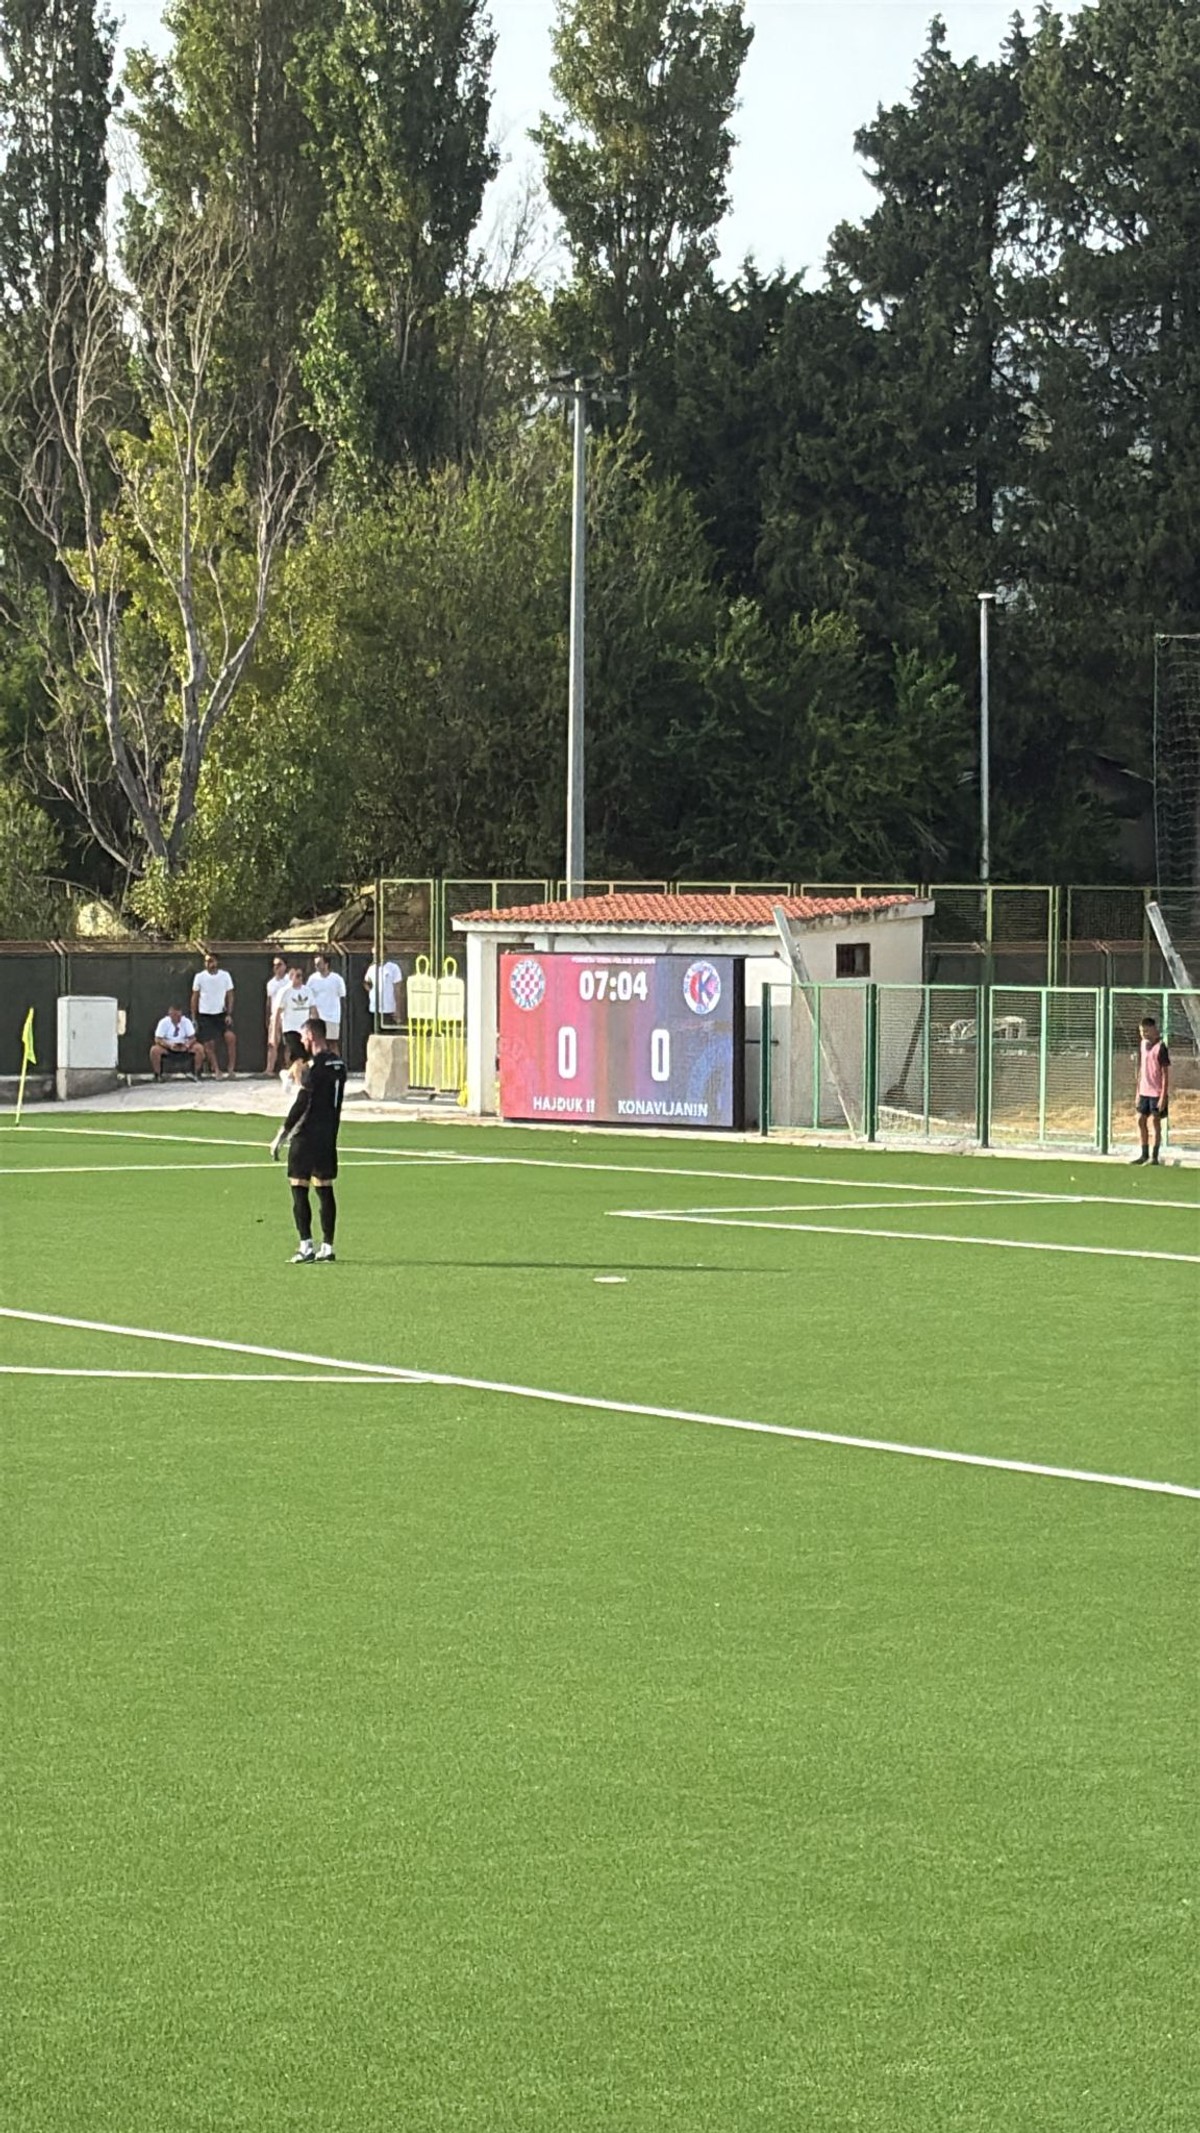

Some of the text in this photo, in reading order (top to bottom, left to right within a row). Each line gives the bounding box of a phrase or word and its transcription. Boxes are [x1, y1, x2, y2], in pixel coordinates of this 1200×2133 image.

[579, 970, 648, 1001] 07:04
[558, 1026, 670, 1081] 0 0
[533, 1096, 583, 1112] HAJDUK
[617, 1099, 709, 1117] KONAVLJANIN
